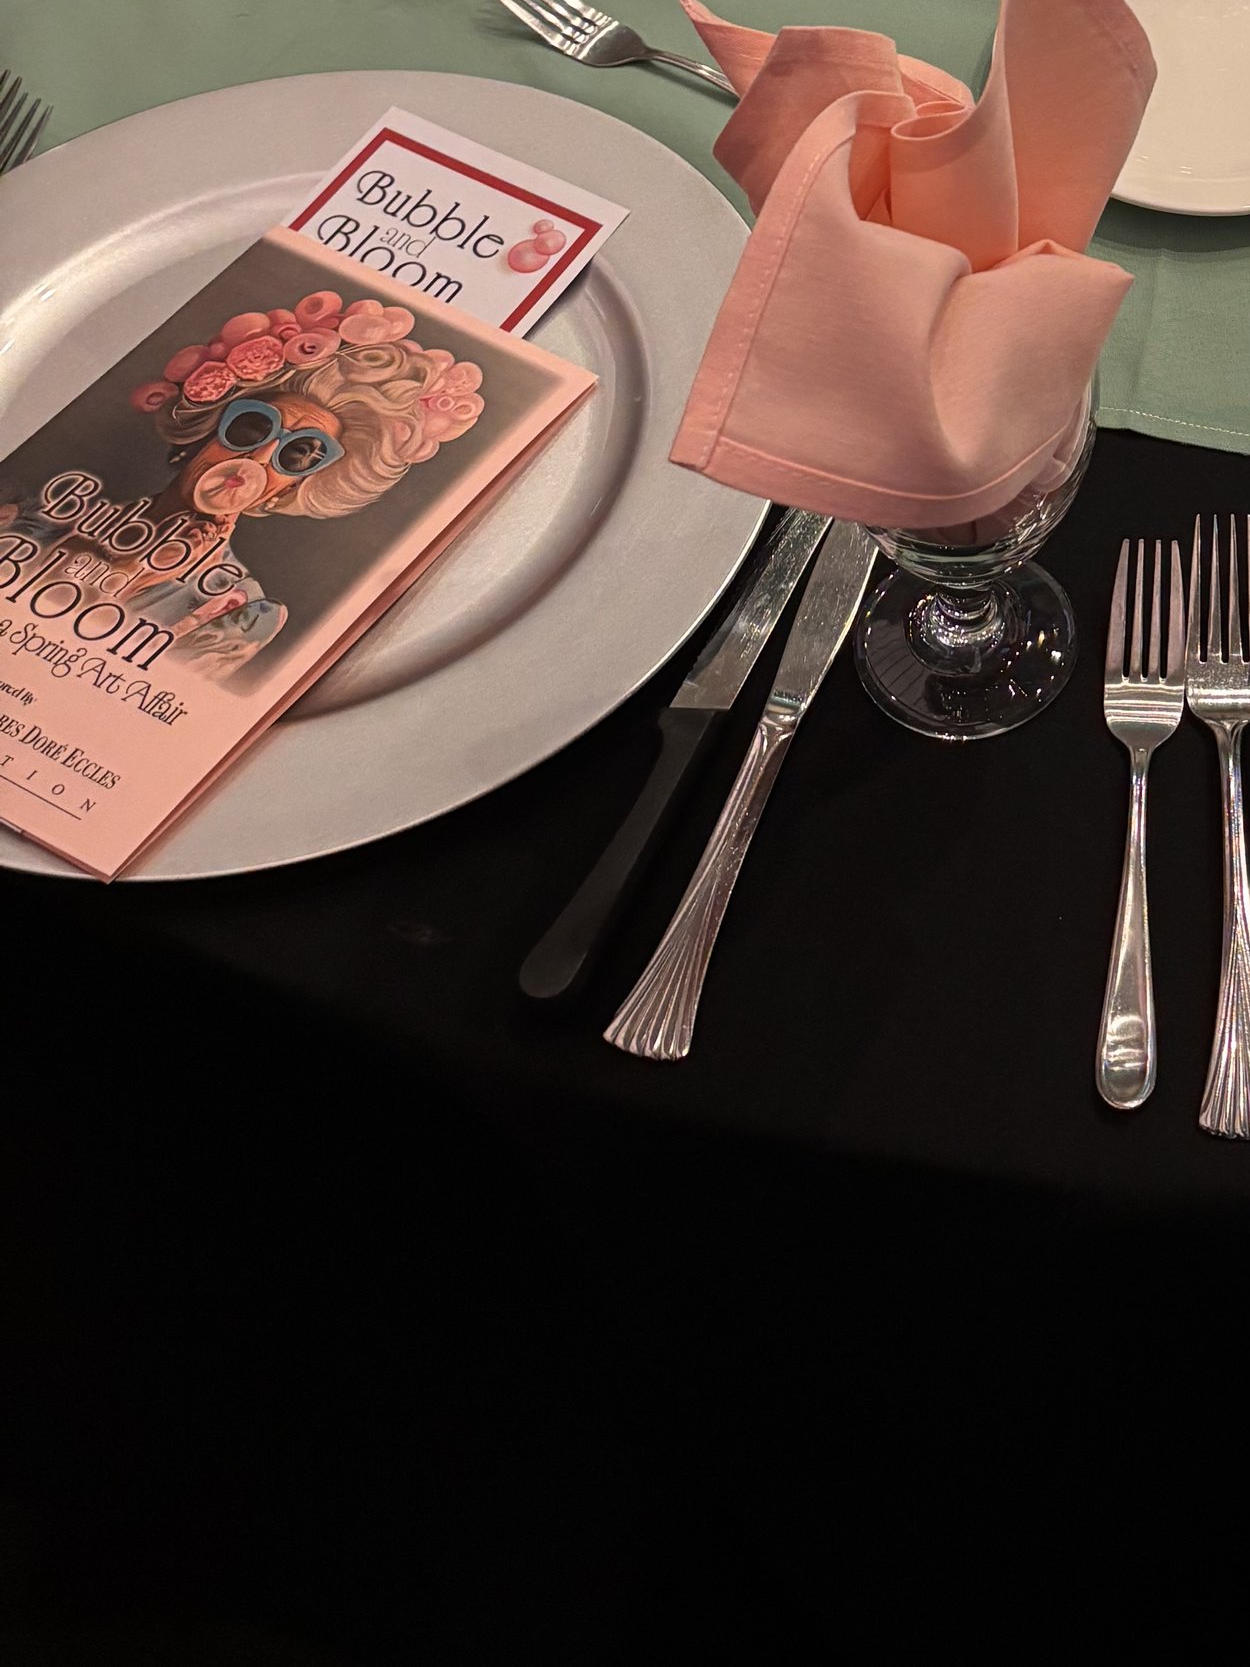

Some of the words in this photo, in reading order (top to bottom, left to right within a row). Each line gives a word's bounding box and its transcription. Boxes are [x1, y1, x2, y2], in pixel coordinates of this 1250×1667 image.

[317, 214, 463, 304] Bloom
[356, 170, 505, 259] Bubble
[380, 226, 437, 259] and
[42, 471, 244, 597] Bubble
[64, 553, 145, 598] and
[0, 534, 176, 672] Bloom
[9, 622, 88, 679] Spring
[76, 657, 126, 694] Art
[121, 680, 189, 726] Affair
